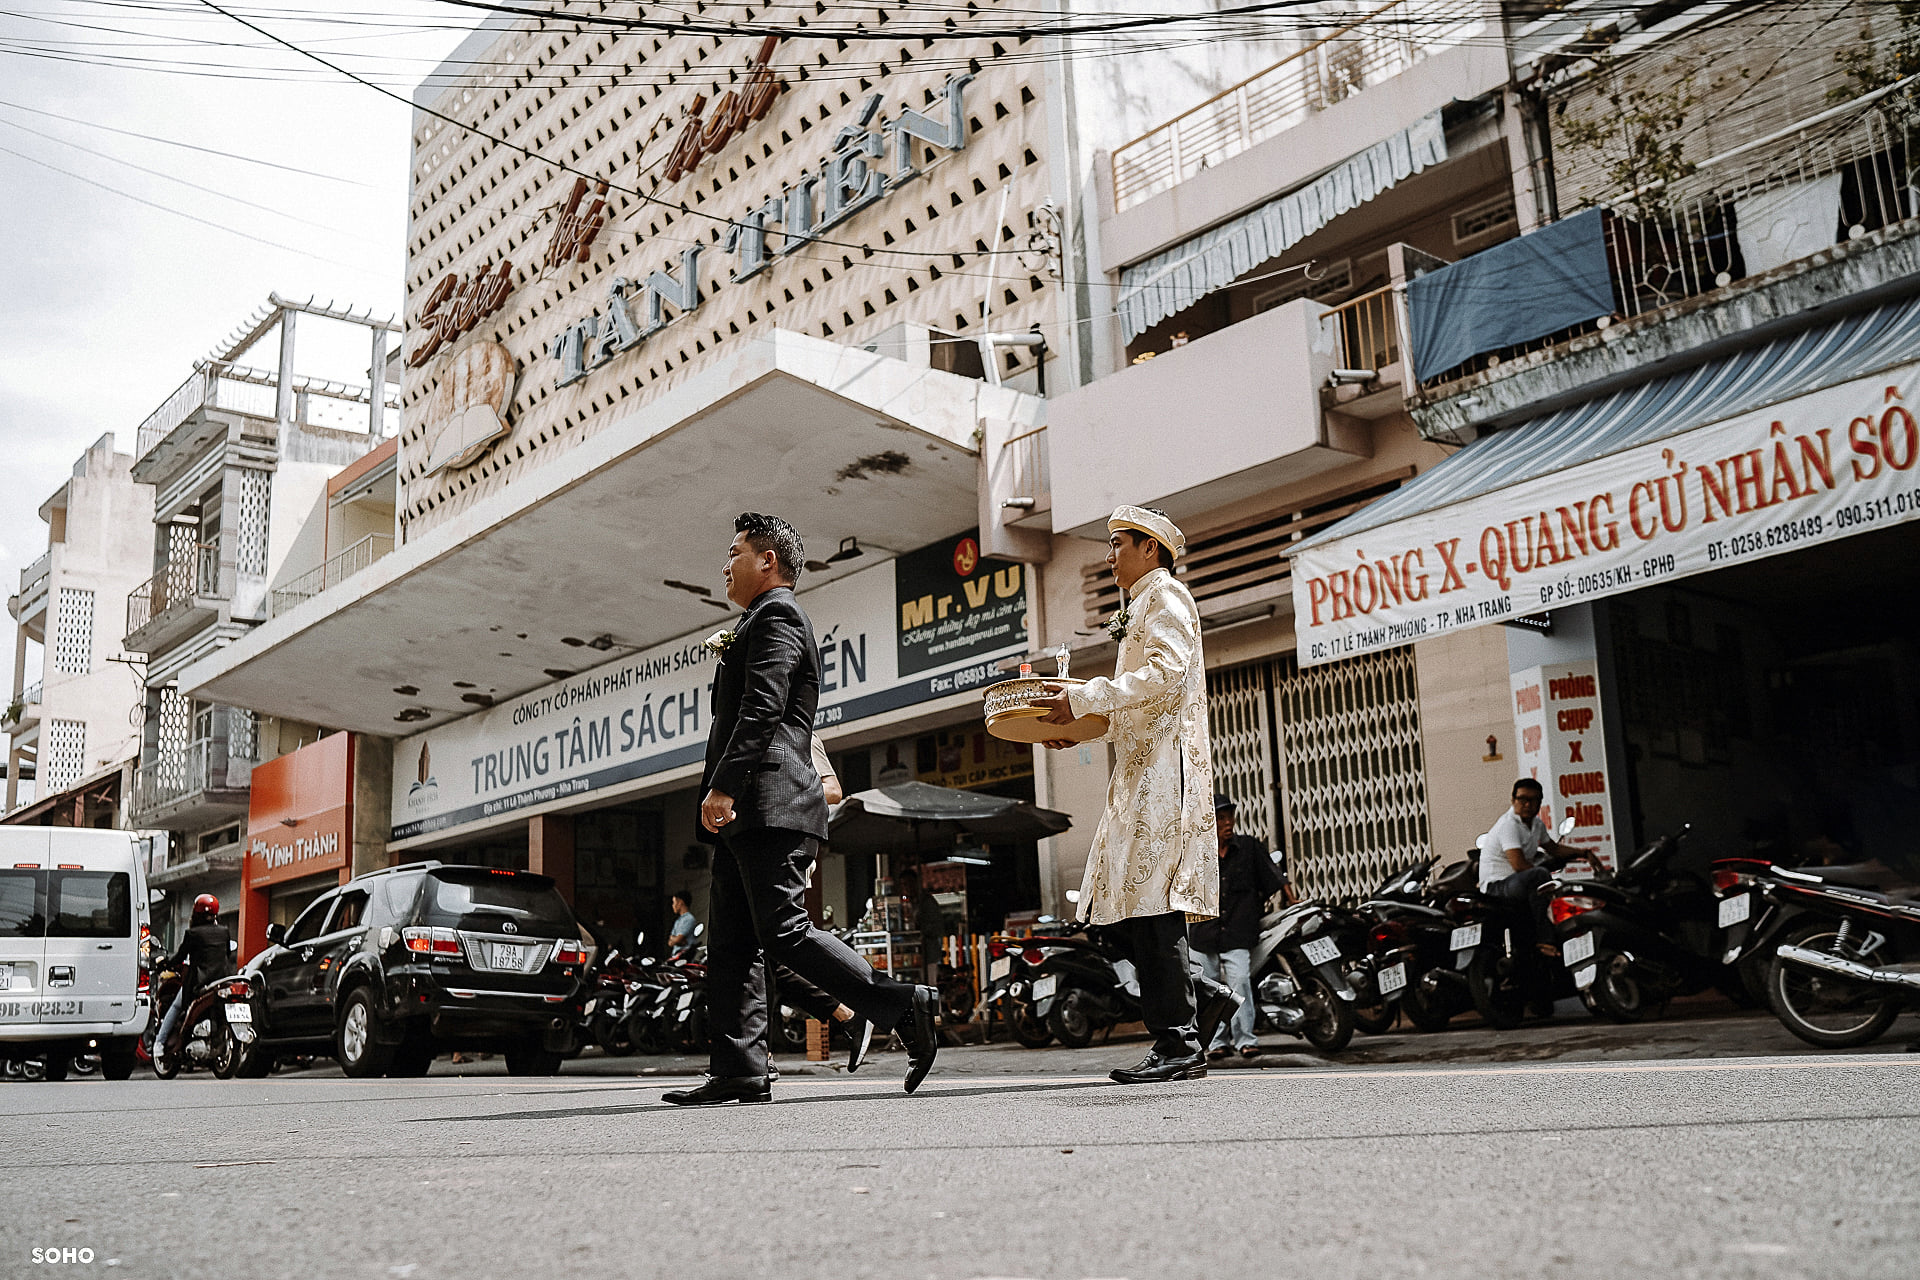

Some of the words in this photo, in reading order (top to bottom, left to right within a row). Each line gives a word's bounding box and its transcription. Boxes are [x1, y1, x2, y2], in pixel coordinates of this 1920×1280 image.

[553, 243, 705, 390] TÂN
[724, 72, 975, 284] TIẾN
[1305, 548, 1430, 628] PHÒNG
[1434, 491, 1621, 595] X-QUANG
[1628, 447, 1689, 541] CỬ
[1696, 420, 1837, 524] NHÂN
[1311, 644, 1327, 659] ĐC:
[1331, 637, 1341, 656] 17
[1388, 617, 1427, 639] PHƯƠNG
[1437, 612, 1453, 631] TP.
[1455, 603, 1476, 625] NHA
[1477, 595, 1512, 619] TRANG
[1540, 586, 1554, 604] GP
[1557, 572, 1576, 600] SỐ:
[1578, 564, 1632, 595] 00635/KH
[1643, 553, 1676, 578] GPHĐ
[1708, 541, 1729, 562] ĐT:
[1731, 515, 1823, 556] 0258.6288489
[512, 700, 540, 725] CÔNG
[541, 696, 555, 716] TY
[603, 666, 634, 696] PHÁT
[635, 656, 672, 684] HÀNH
[673, 644, 708, 672] SÁCH
[1549, 672, 1597, 701] PHÒNG
[1557, 707, 1594, 735] CHỤP
[471, 735, 549, 795] TRUNG
[555, 716, 612, 769] TÂM
[620, 687, 700, 752] SÁCH
[1568, 741, 1584, 763] X
[1558, 771, 1606, 799] QUANG
